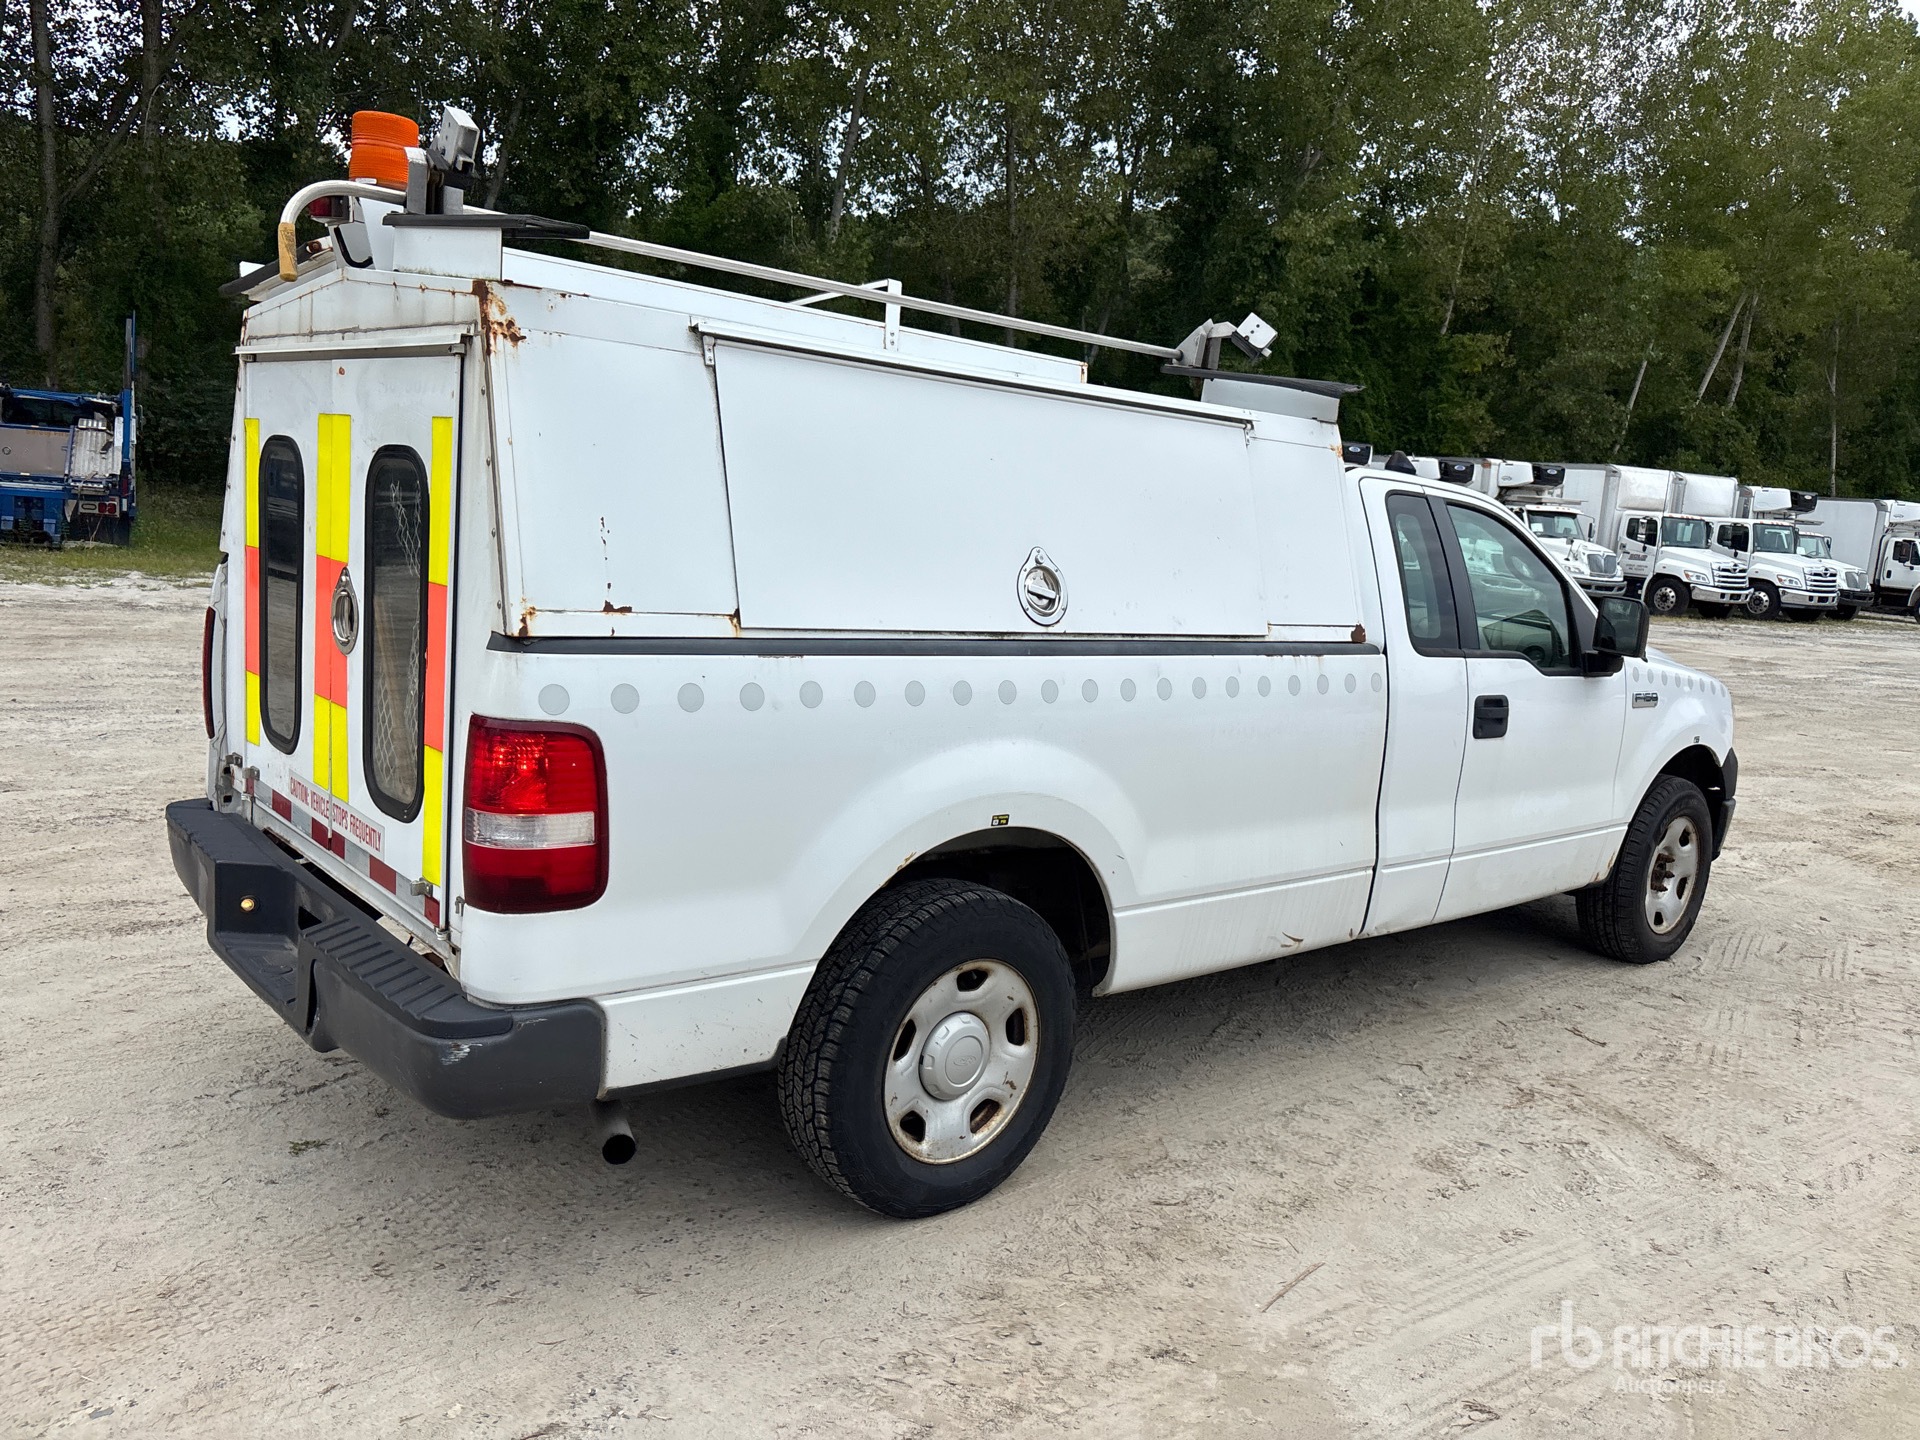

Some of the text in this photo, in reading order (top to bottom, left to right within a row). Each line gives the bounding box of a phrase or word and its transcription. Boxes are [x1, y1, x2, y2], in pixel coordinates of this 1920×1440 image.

[310, 789, 329, 819] VEHICLE
[332, 802, 348, 831] STOPS
[350, 813, 381, 853] FREQUENTLY
